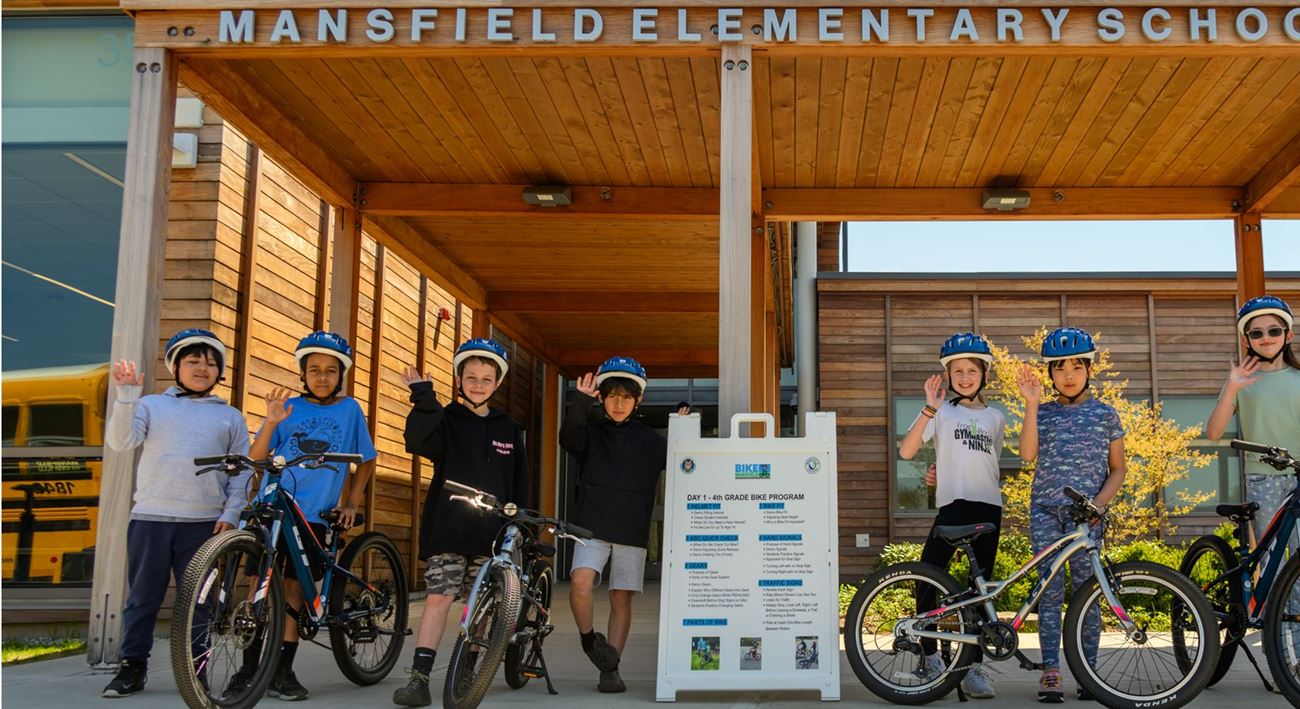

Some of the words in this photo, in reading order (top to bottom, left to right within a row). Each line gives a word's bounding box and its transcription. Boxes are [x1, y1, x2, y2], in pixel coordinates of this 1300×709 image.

[218, 8, 603, 42] MANSFIELD
[631, 7, 1069, 42] ELEMENTARY
[97, 32, 134, 67] 3
[968, 440, 992, 455] NINJA
[735, 464, 758, 472] BIKE
[880, 570, 912, 583] KENDA
[1135, 694, 1176, 708] KENDA
